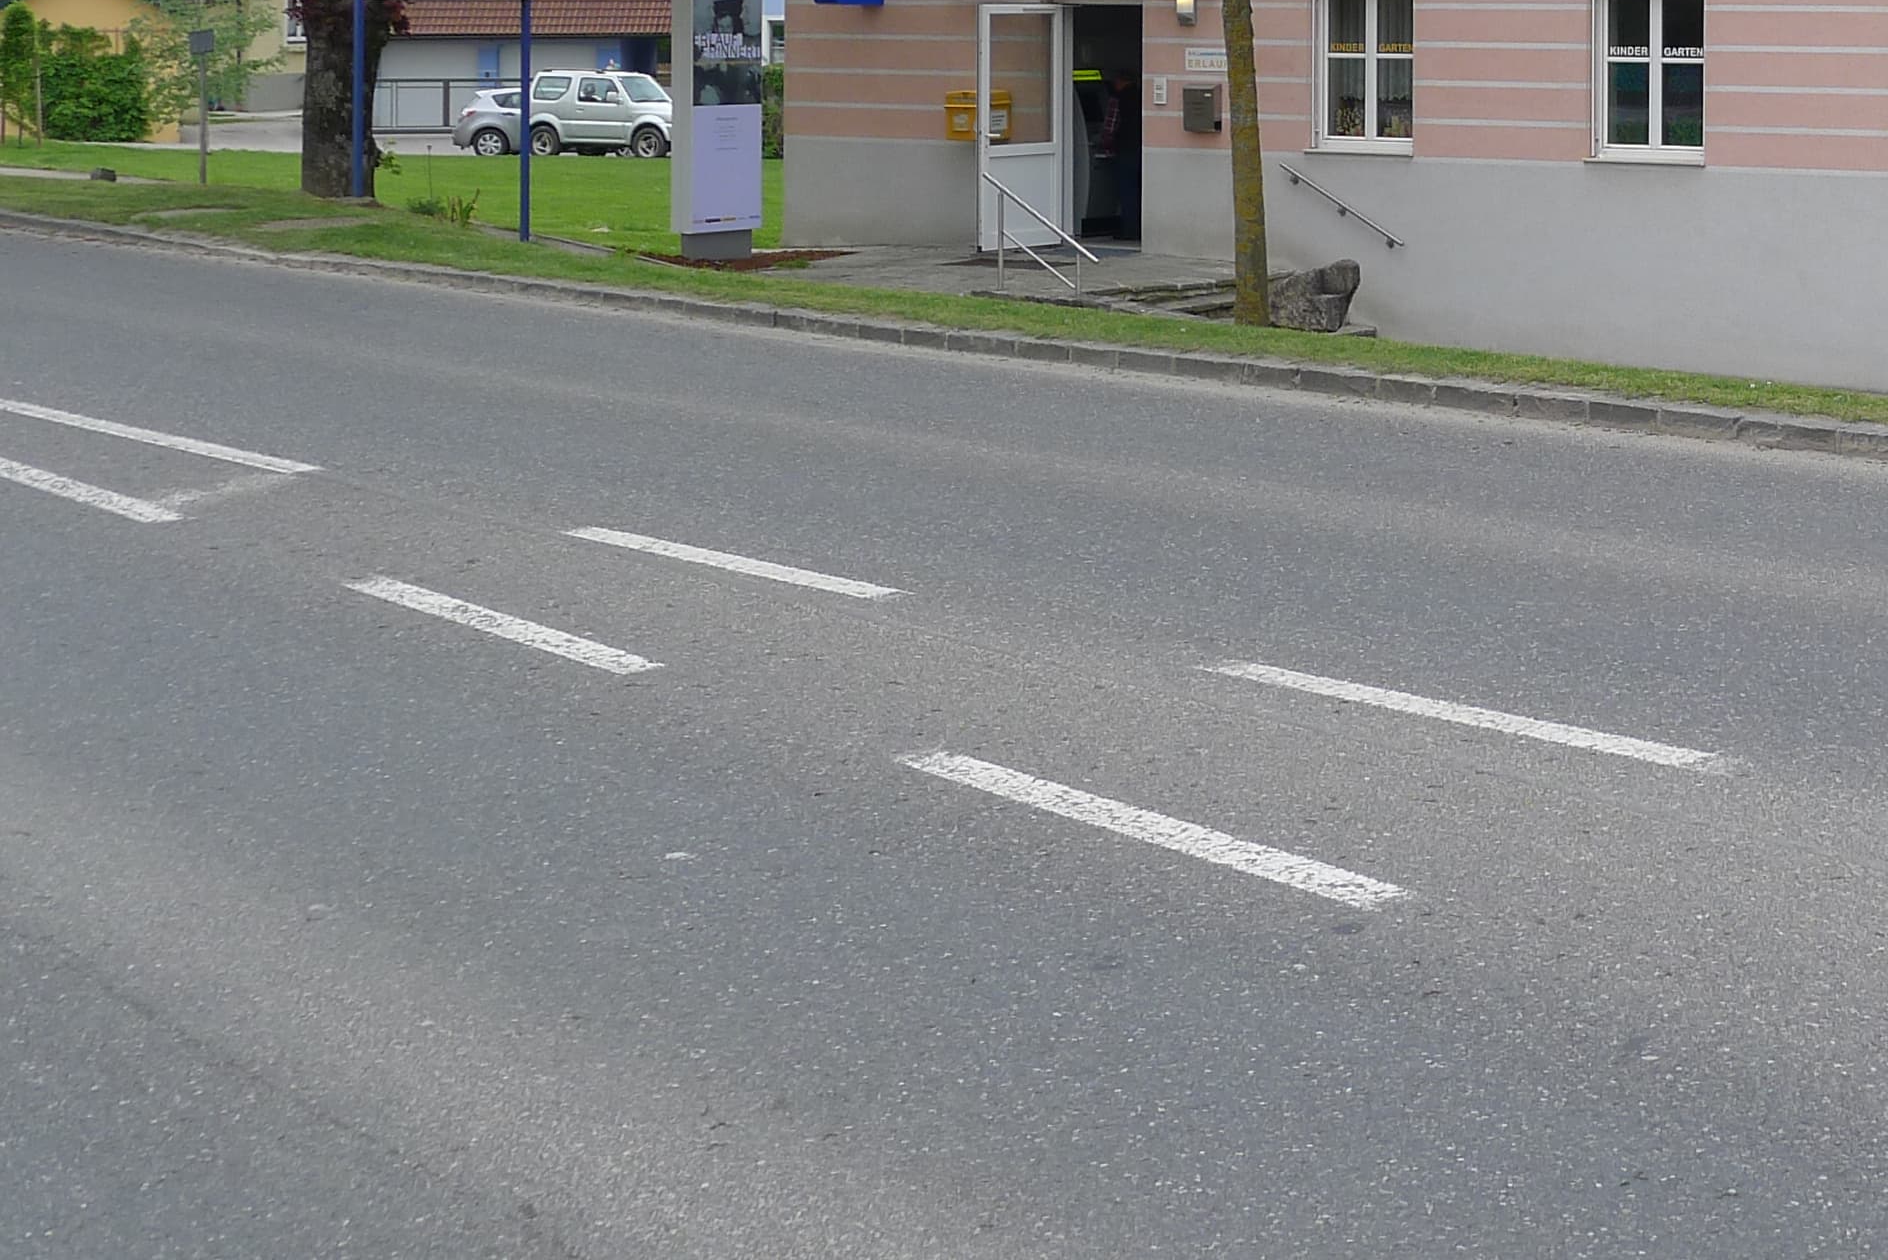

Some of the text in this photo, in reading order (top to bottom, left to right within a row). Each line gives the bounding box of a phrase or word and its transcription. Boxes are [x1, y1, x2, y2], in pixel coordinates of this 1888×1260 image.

[1331, 43, 1365, 53] KINDER
[1609, 46, 1703, 57] KINDER GARTEN
